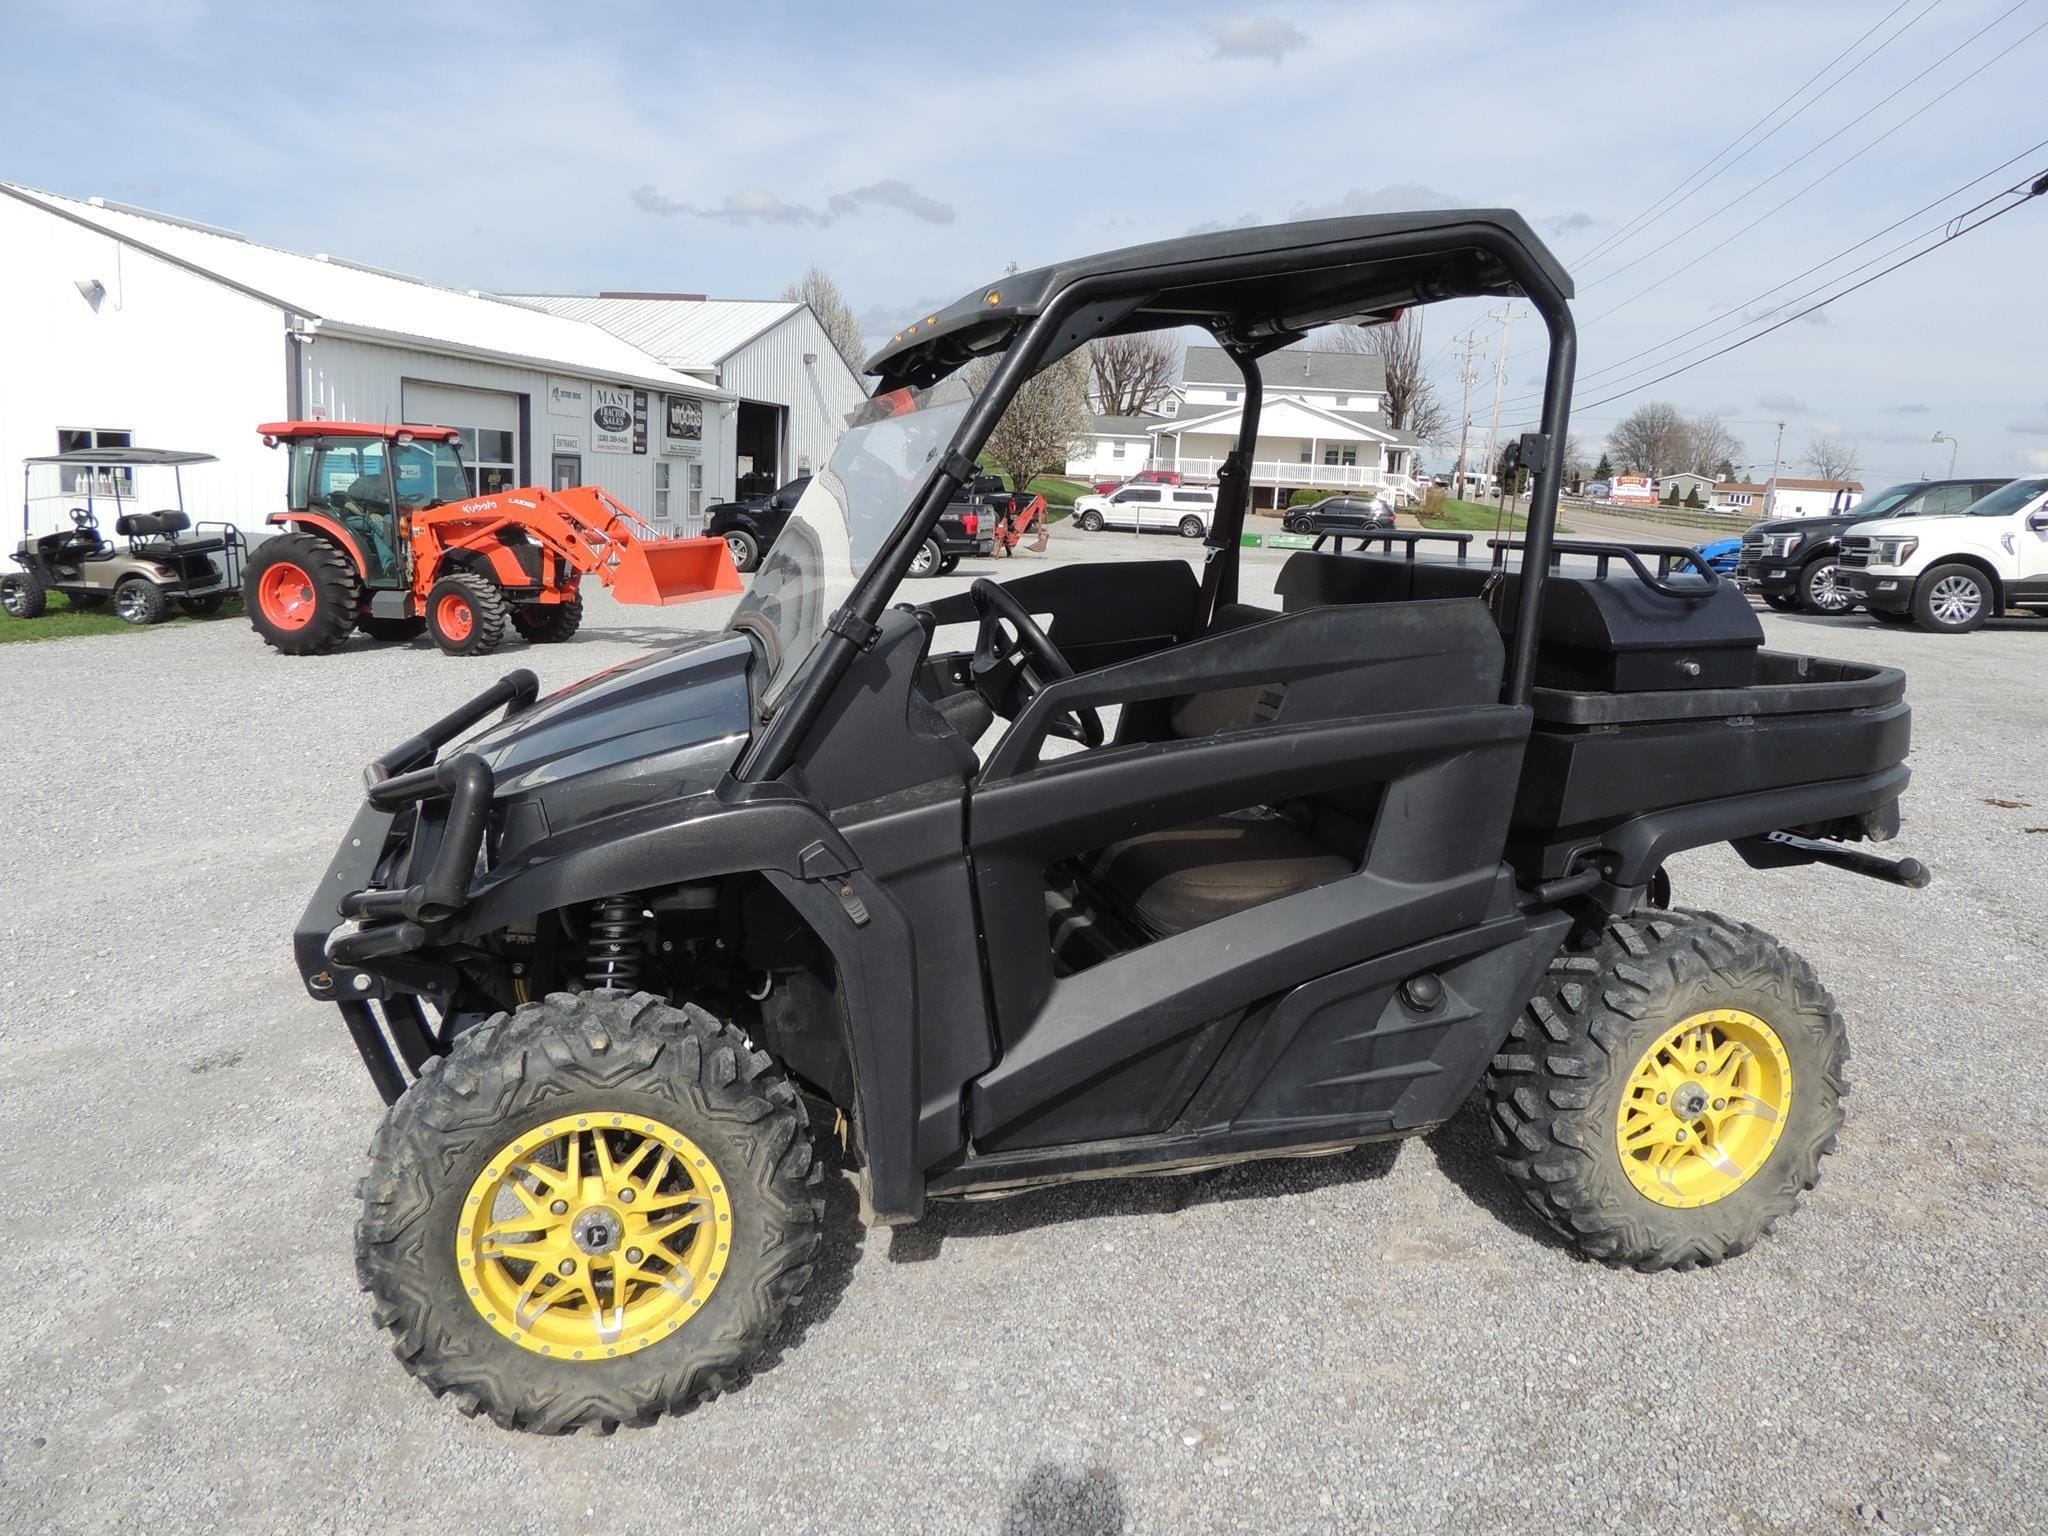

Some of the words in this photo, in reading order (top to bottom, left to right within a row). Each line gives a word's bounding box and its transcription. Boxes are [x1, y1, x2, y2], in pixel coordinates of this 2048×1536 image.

[597, 390, 631, 408] MAST
[603, 415, 625, 426] SALES
[671, 405, 702, 427] WOODS
[462, 501, 497, 513] Kubota
